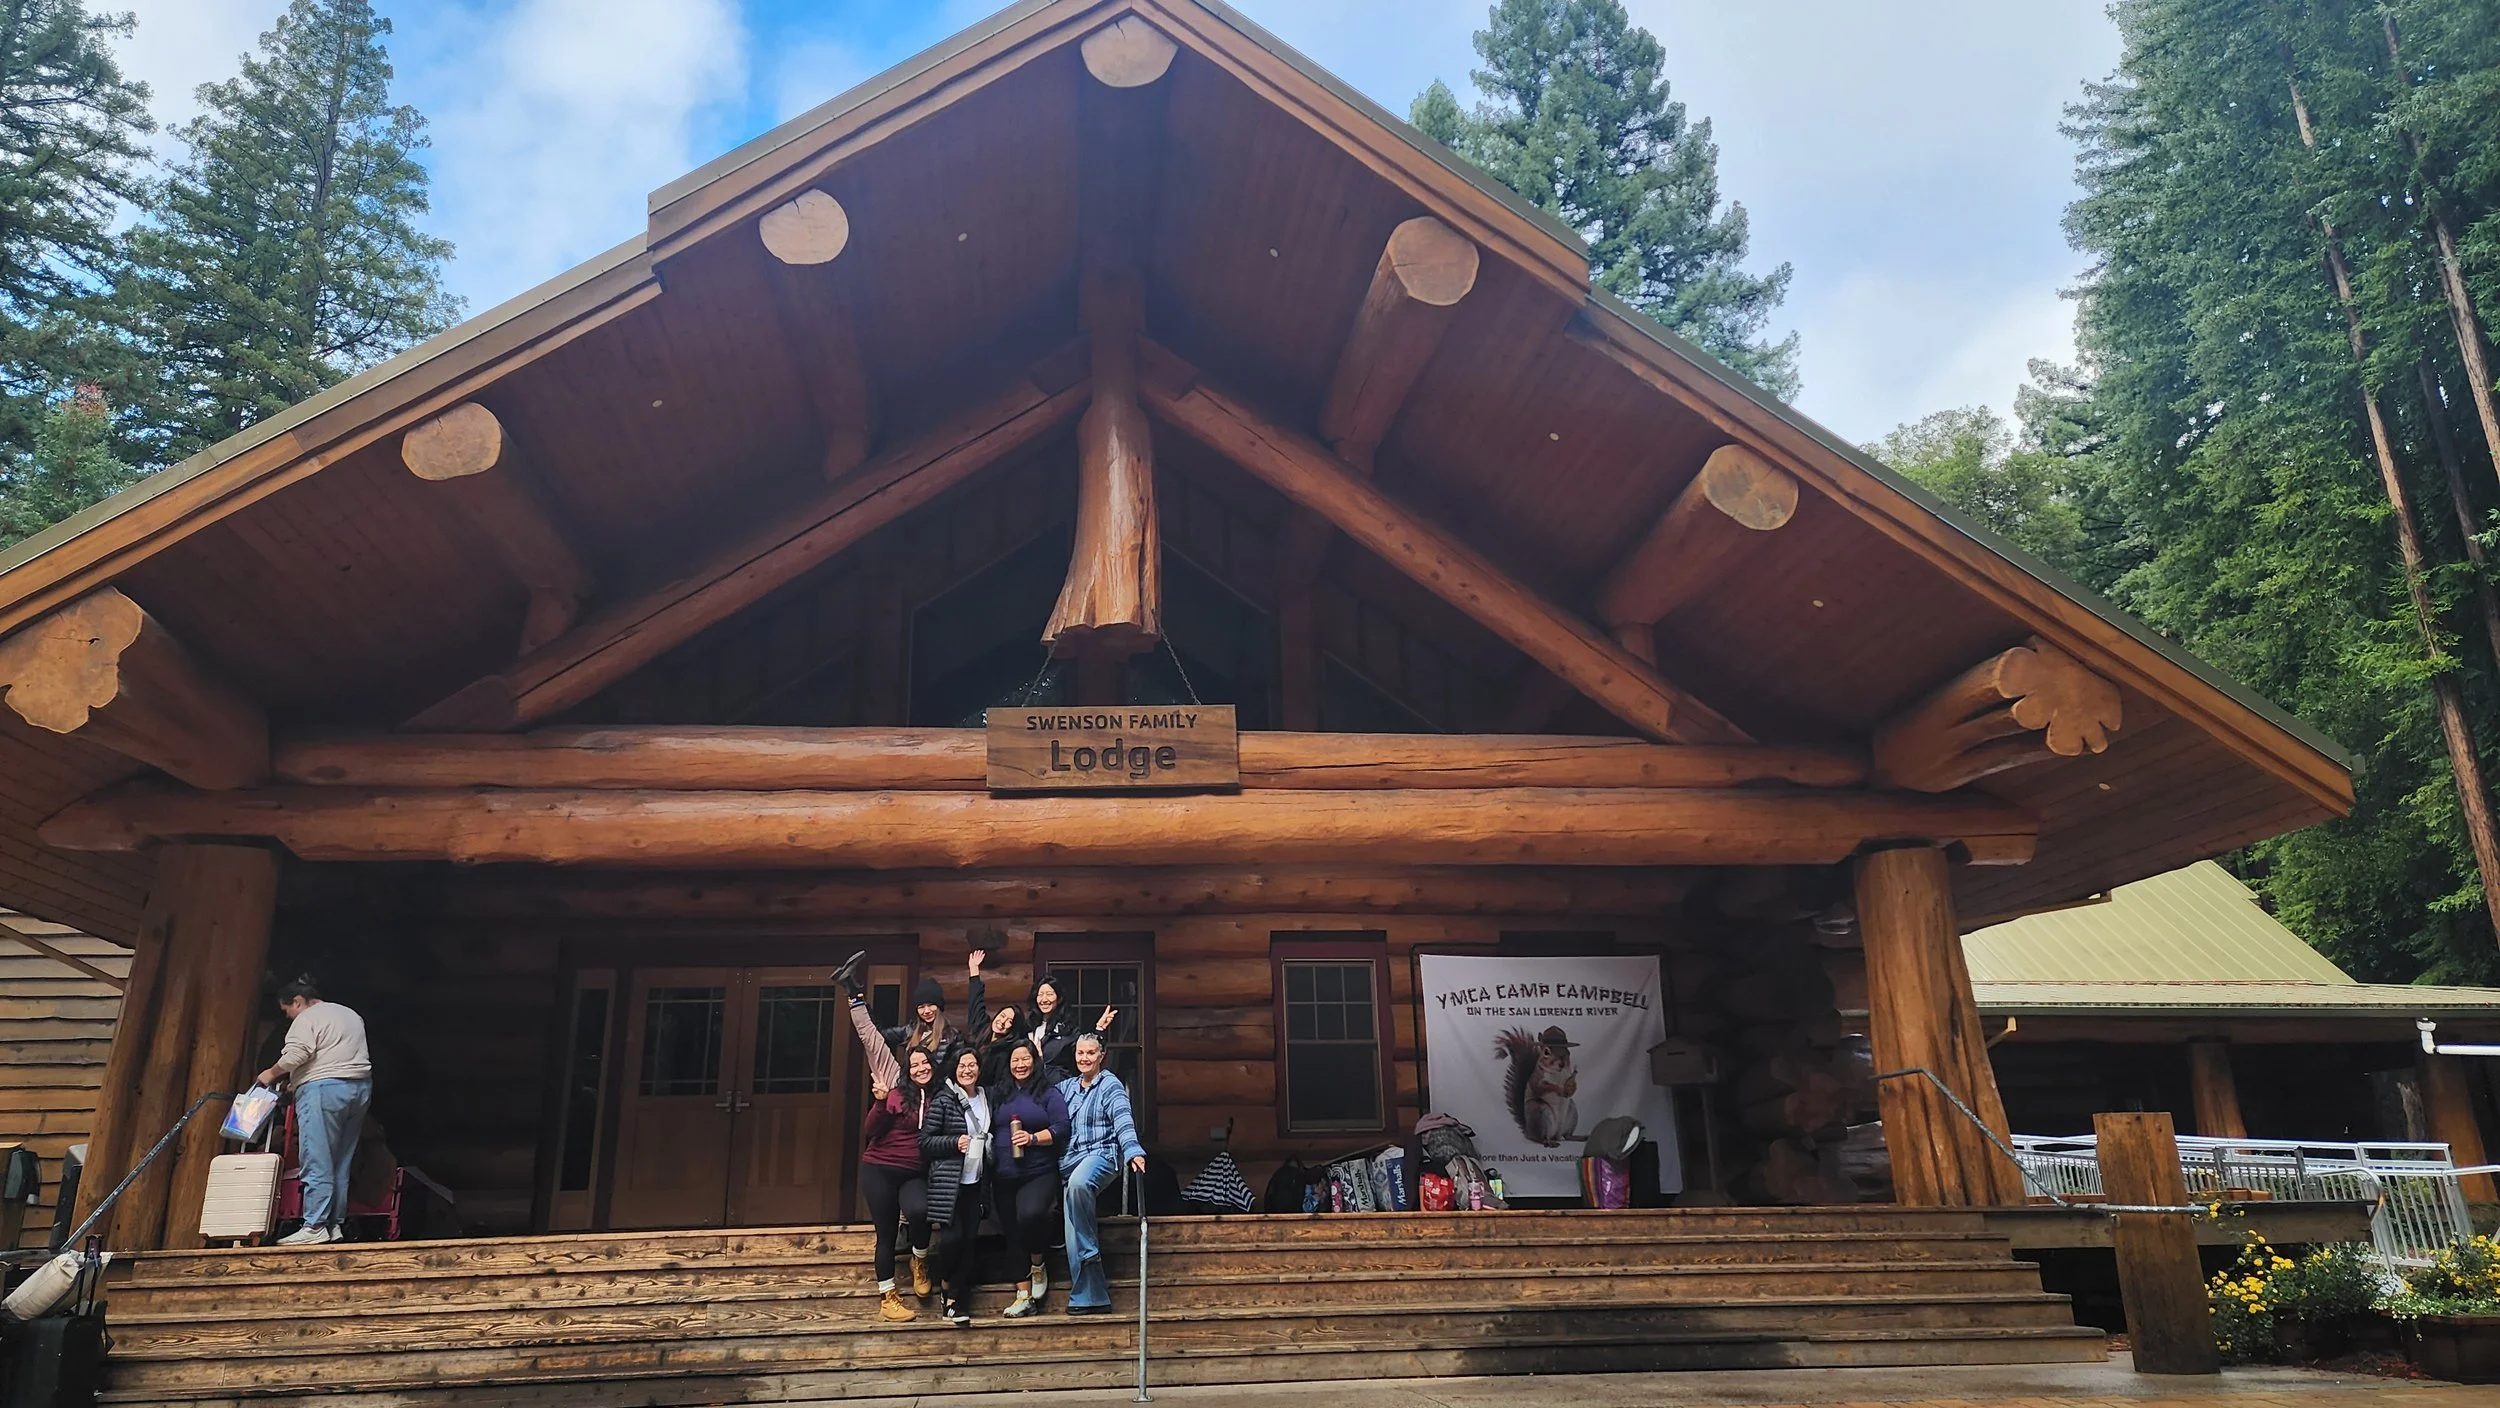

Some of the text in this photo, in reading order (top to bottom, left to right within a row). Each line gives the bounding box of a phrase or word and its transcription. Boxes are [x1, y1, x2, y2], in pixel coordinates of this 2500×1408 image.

[1026, 713, 1198, 731] SWENSON FAMILY
[1050, 738, 1177, 780] Lodge
[1436, 982, 1649, 1010] YMCA CAMP CAMPBELL
[1467, 1006, 1619, 1016] ON THE SAN LORENZO RIVER
[1499, 1153, 1519, 1162] than
[1520, 1153, 1540, 1162] Just
[1549, 1154, 1579, 1162] Vacatio
[1393, 1164, 1408, 1206] Marshalls
